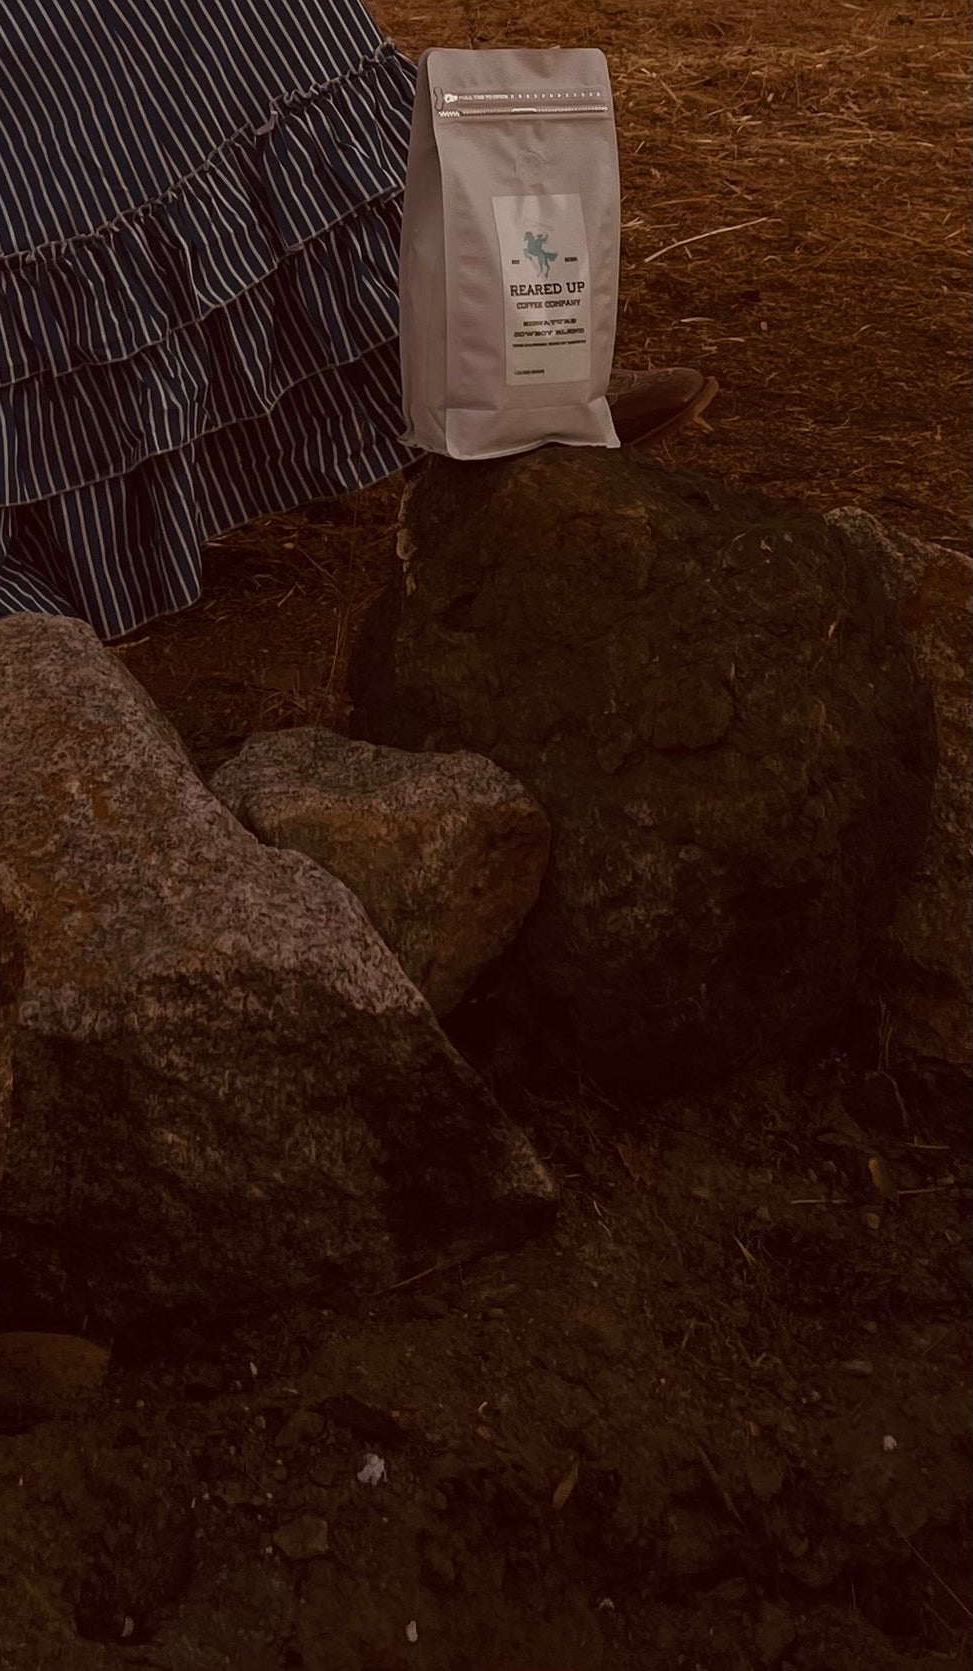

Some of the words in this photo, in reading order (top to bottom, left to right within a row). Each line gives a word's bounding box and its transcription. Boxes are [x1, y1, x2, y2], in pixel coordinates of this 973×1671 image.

[510, 283, 562, 296] REARED
[566, 282, 585, 293] UP
[544, 299, 580, 308] COMPANY
